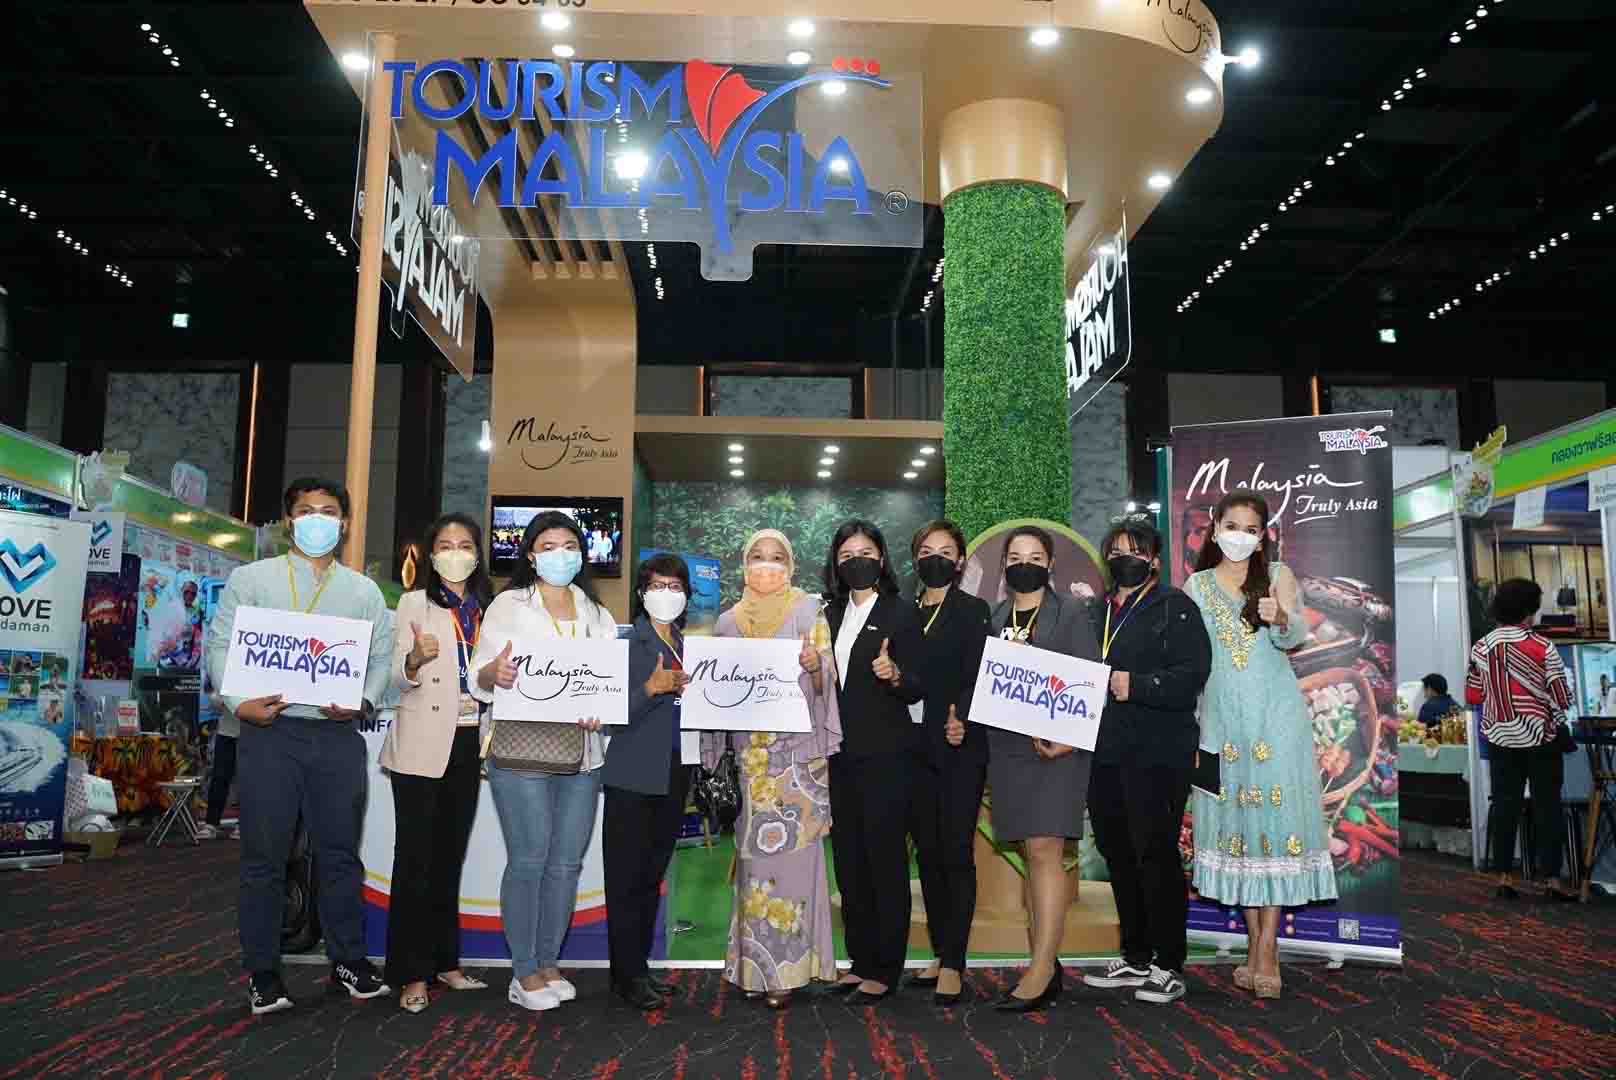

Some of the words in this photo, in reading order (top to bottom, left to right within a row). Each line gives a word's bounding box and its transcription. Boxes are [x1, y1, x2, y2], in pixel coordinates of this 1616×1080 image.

[383, 59, 683, 123] TOURISM
[432, 128, 872, 253] MALAYSIA
[507, 417, 611, 470] Malaysia
[1327, 437, 1381, 453] MALAYSIA
[1295, 496, 1341, 518] Truly
[1345, 498, 1378, 511] Asia
[0, 596, 52, 619] OVE
[0, 619, 50, 633] daman
[238, 630, 308, 652] TOURISM
[245, 648, 351, 683] MALAYSIA
[512, 655, 614, 700] Malaysia
[688, 658, 798, 708] Malaysia
[985, 660, 1049, 688] TOURISM
[992, 678, 1087, 719] MALAYSIA
